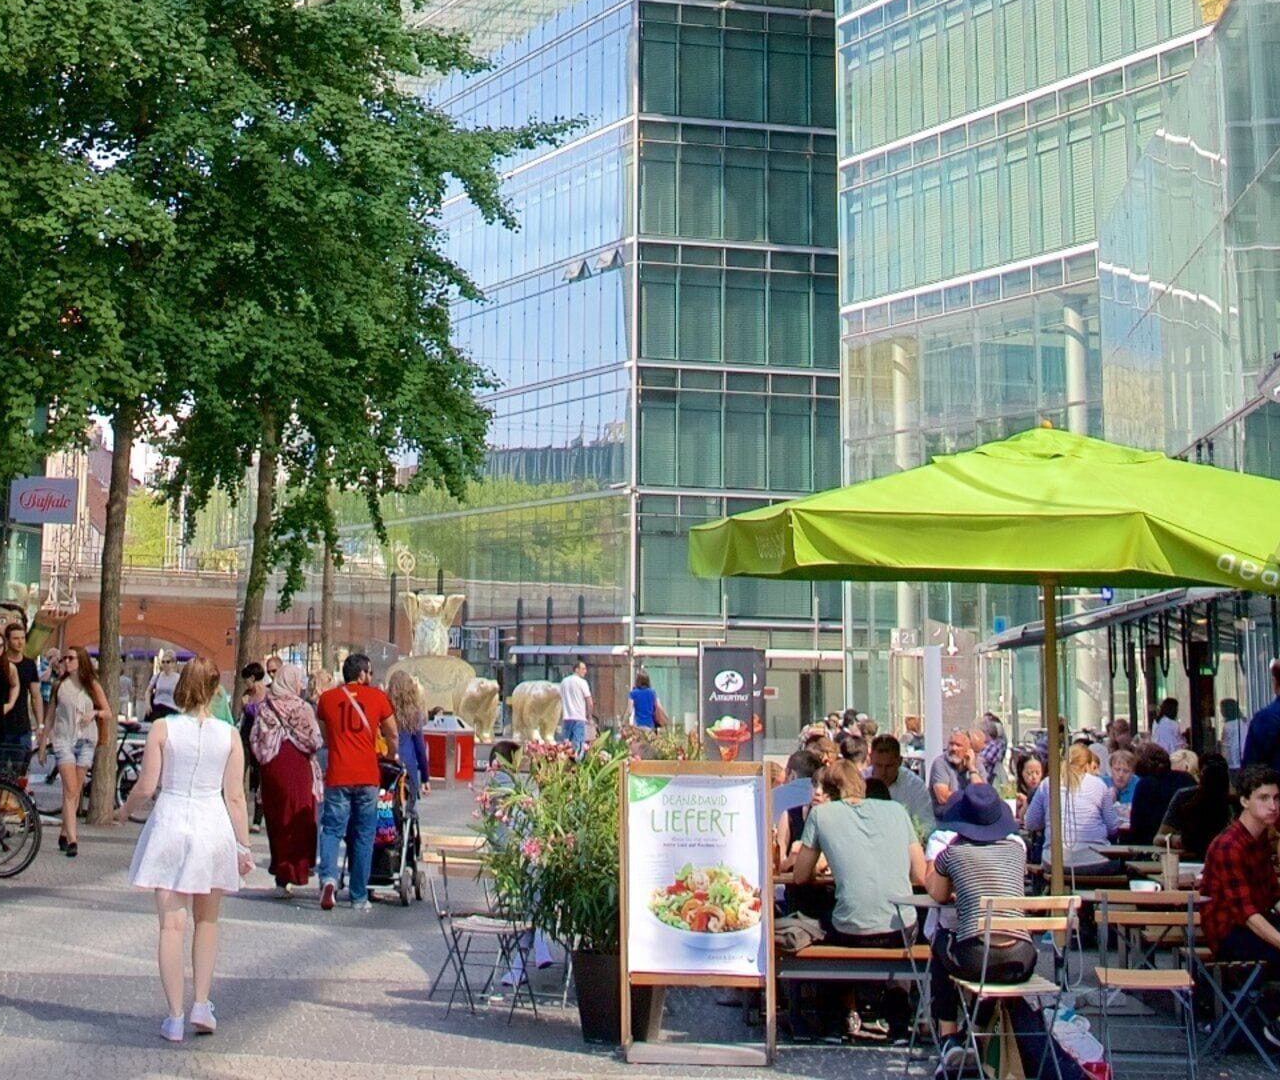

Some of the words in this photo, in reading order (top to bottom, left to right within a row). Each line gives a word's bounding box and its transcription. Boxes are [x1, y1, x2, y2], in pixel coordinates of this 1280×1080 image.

[19, 487, 72, 513] Buffalo
[708, 690, 749, 702] Amorino
[337, 700, 366, 734] 10
[662, 793, 728, 807] DEAN&DAVID
[650, 808, 740, 838] LIEFERT
